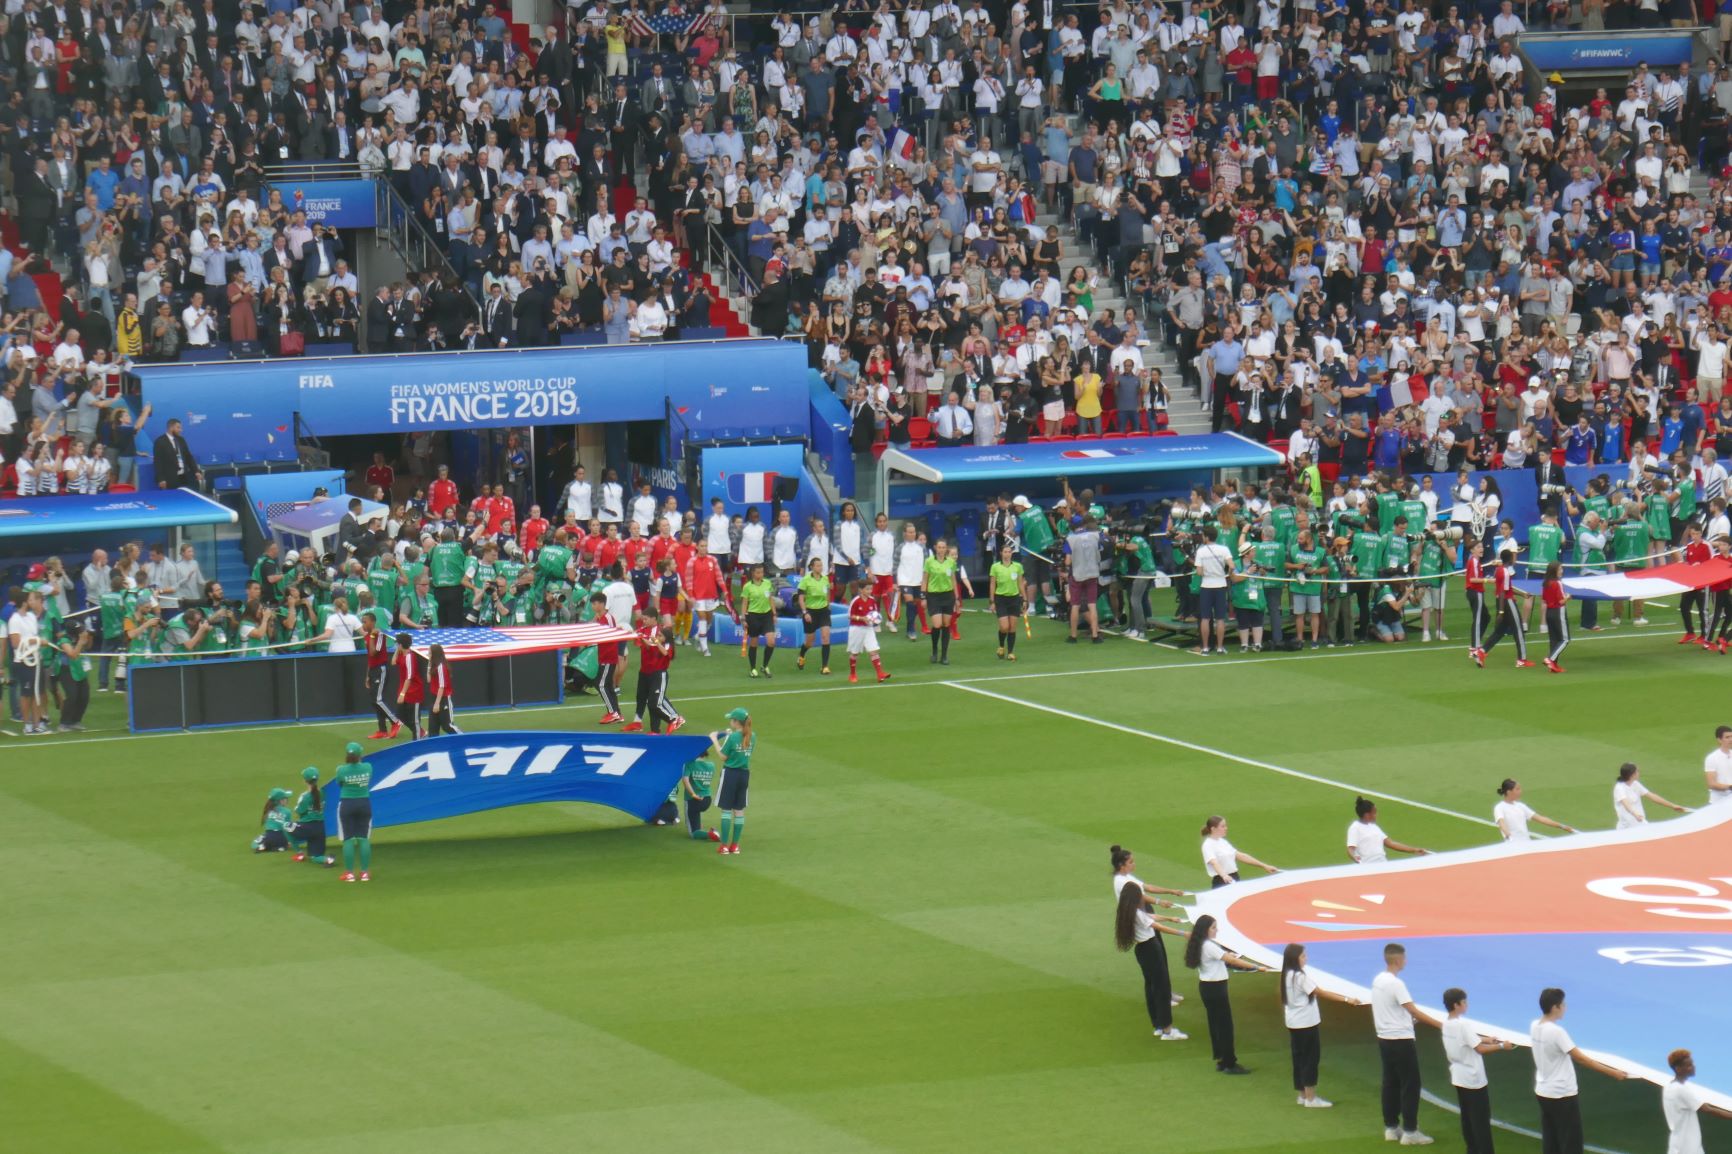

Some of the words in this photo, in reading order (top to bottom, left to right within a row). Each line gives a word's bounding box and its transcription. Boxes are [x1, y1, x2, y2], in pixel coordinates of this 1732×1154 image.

[1580, 48, 1624, 58] #FIFAWWC
[305, 202, 342, 211] FRANCE
[306, 210, 327, 220] 2019
[299, 375, 334, 389] FIFA
[391, 384, 421, 397] FIFA
[423, 380, 490, 396] WOMEN'S
[493, 378, 545, 393] WORLD
[547, 376, 577, 390] CUP
[388, 393, 510, 424] FRANCE
[514, 389, 578, 418] 2019
[651, 468, 677, 491] PARIS
